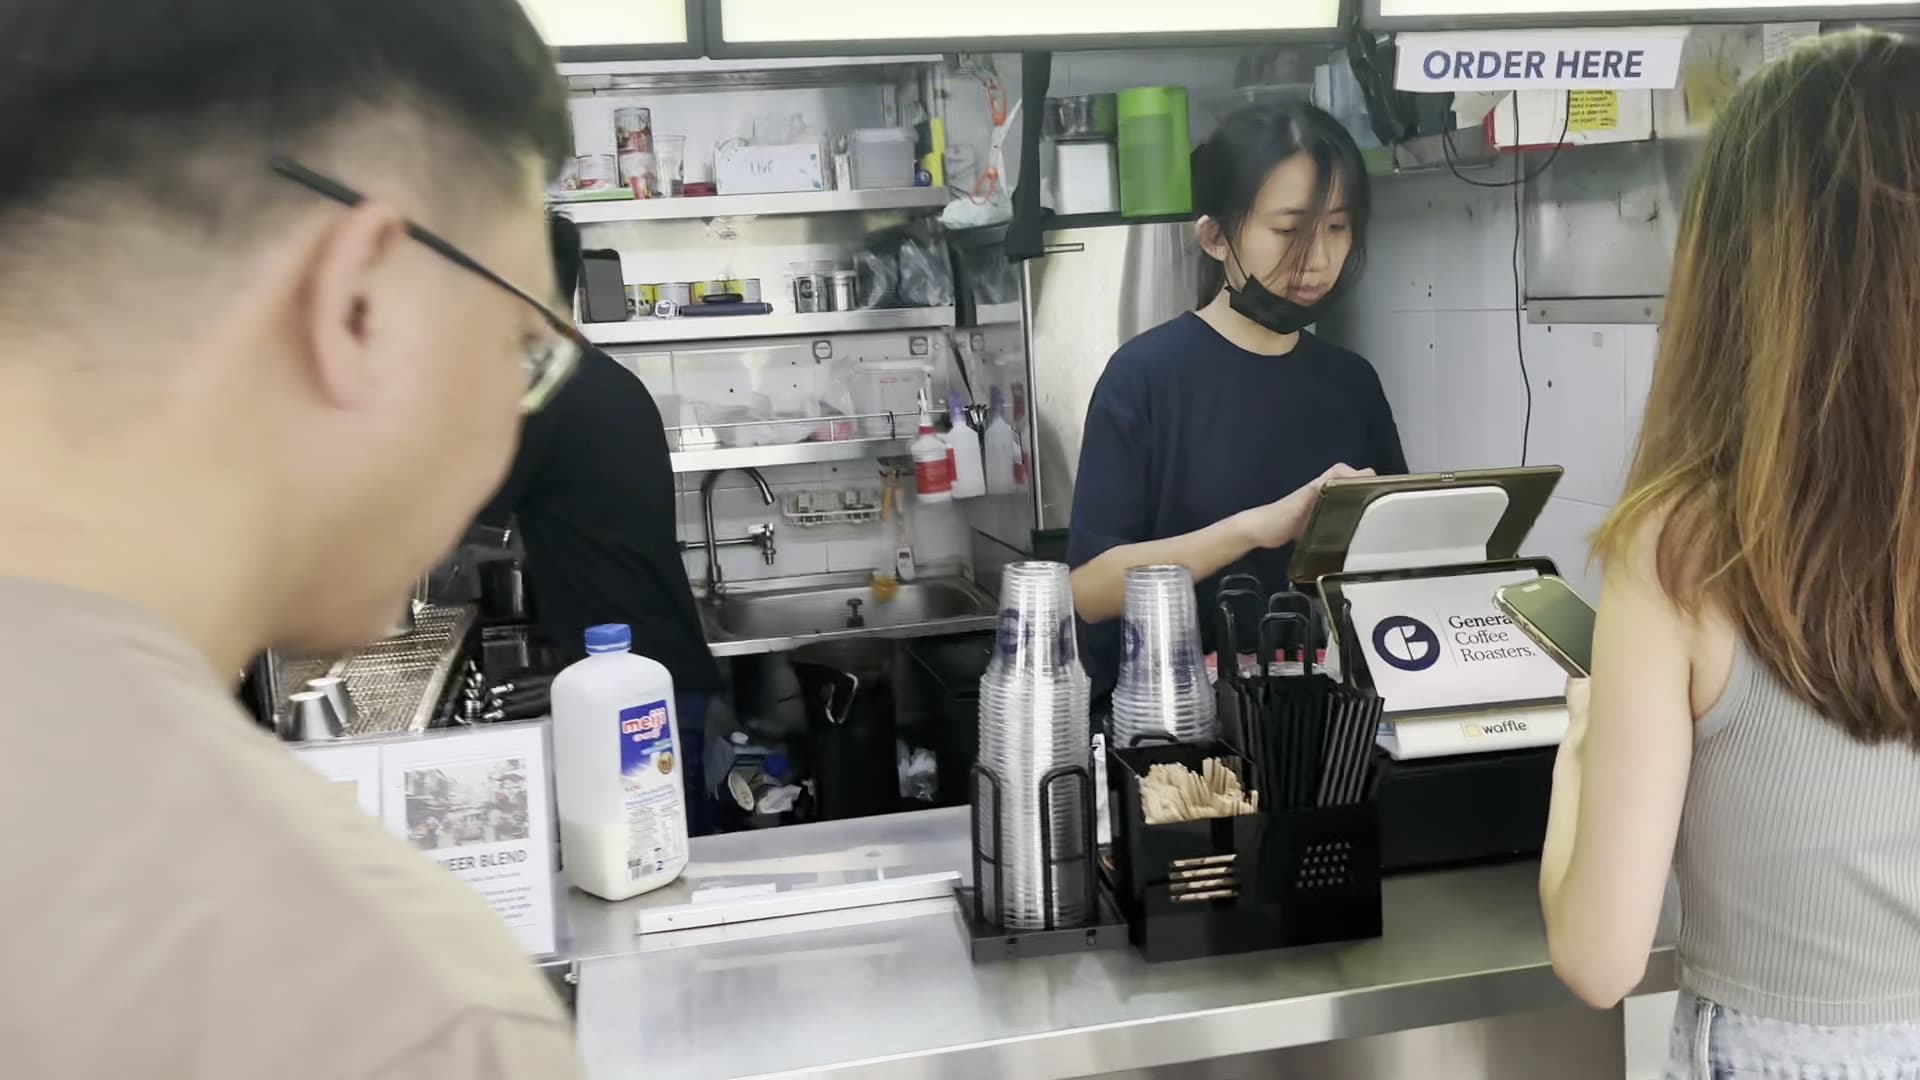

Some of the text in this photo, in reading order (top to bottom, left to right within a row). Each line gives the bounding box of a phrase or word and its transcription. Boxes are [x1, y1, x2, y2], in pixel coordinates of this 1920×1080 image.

[1423, 50, 1644, 79] ORDER HERE
[1448, 614, 1513, 629] Genera
[1455, 629, 1509, 646] Coffee
[1460, 646, 1537, 663] Roasters.
[622, 706, 667, 734] meiji
[1481, 719, 1528, 735] waffle
[480, 849, 528, 868] BLEND
